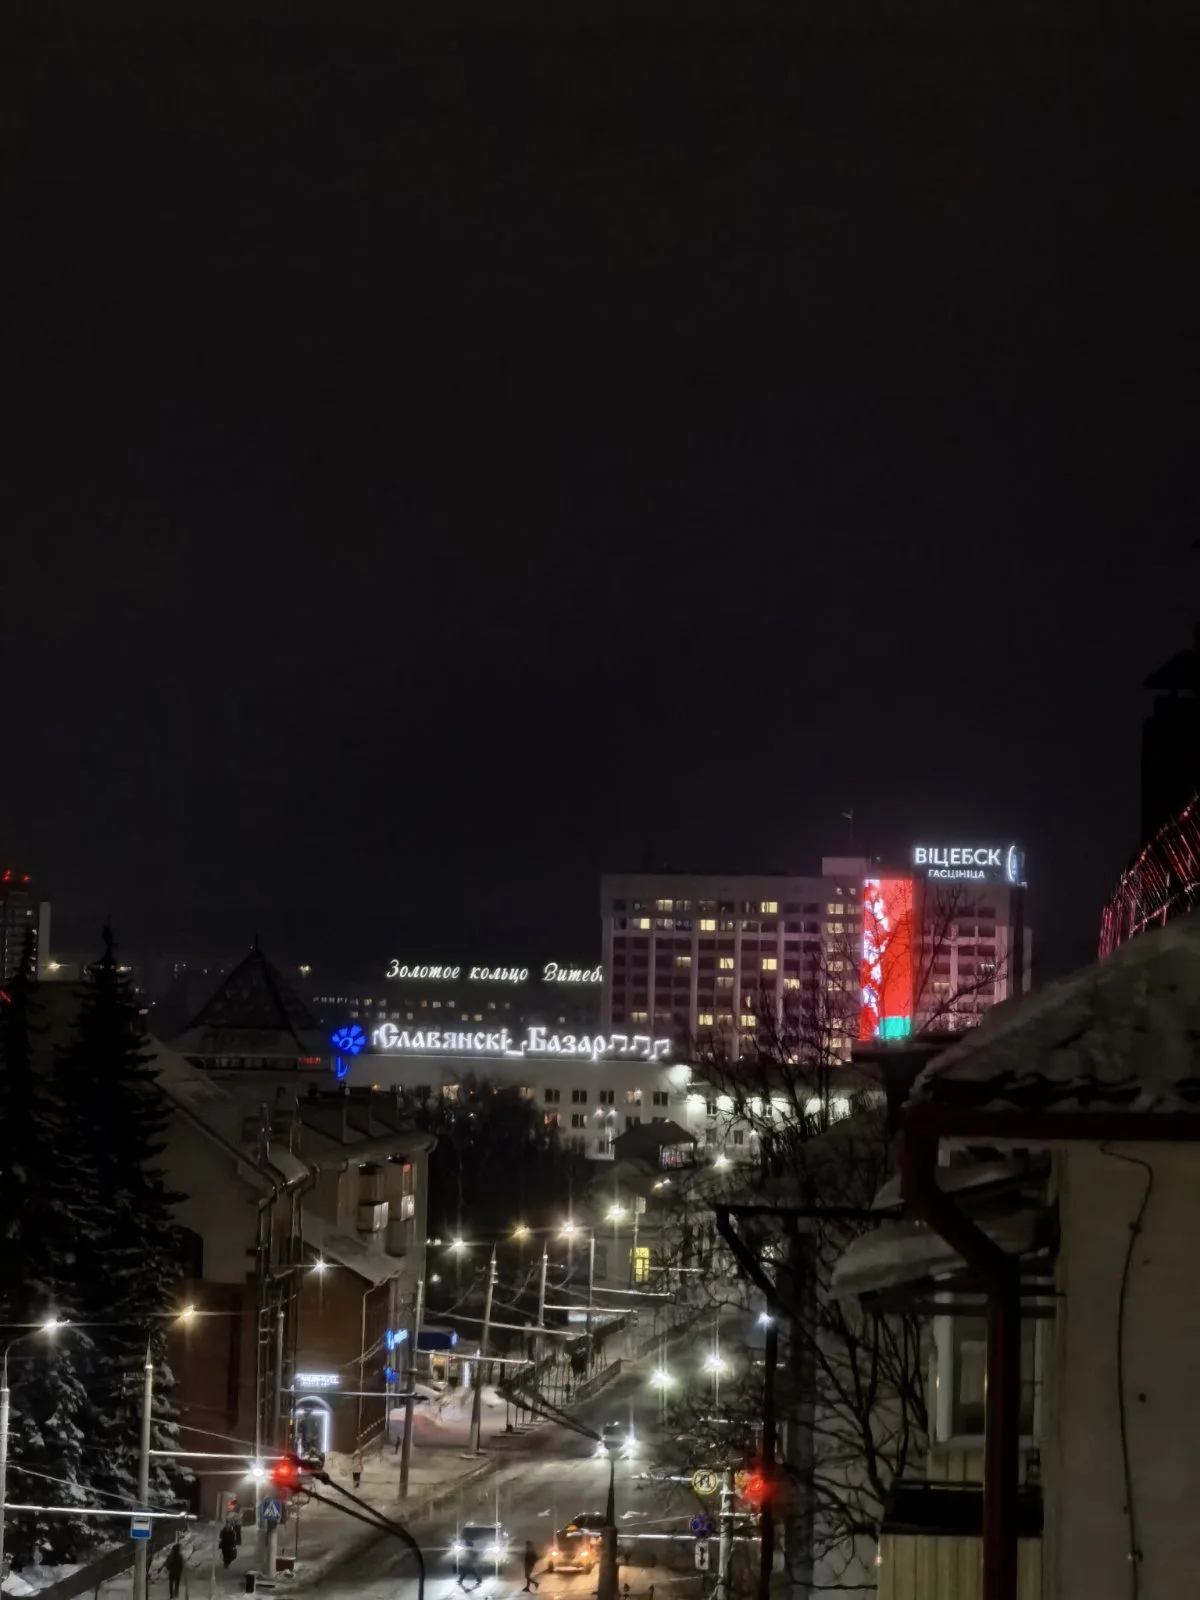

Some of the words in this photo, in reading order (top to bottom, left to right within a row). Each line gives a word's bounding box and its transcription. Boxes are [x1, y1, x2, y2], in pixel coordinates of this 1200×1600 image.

[914, 847, 1001, 867] ВІЦЕБСК
[928, 869, 985, 879] ГАСЦІНІЦА
[386, 959, 460, 980] Золотое
[469, 966, 528, 983] кольцо
[527, 1026, 606, 1062] Базар
